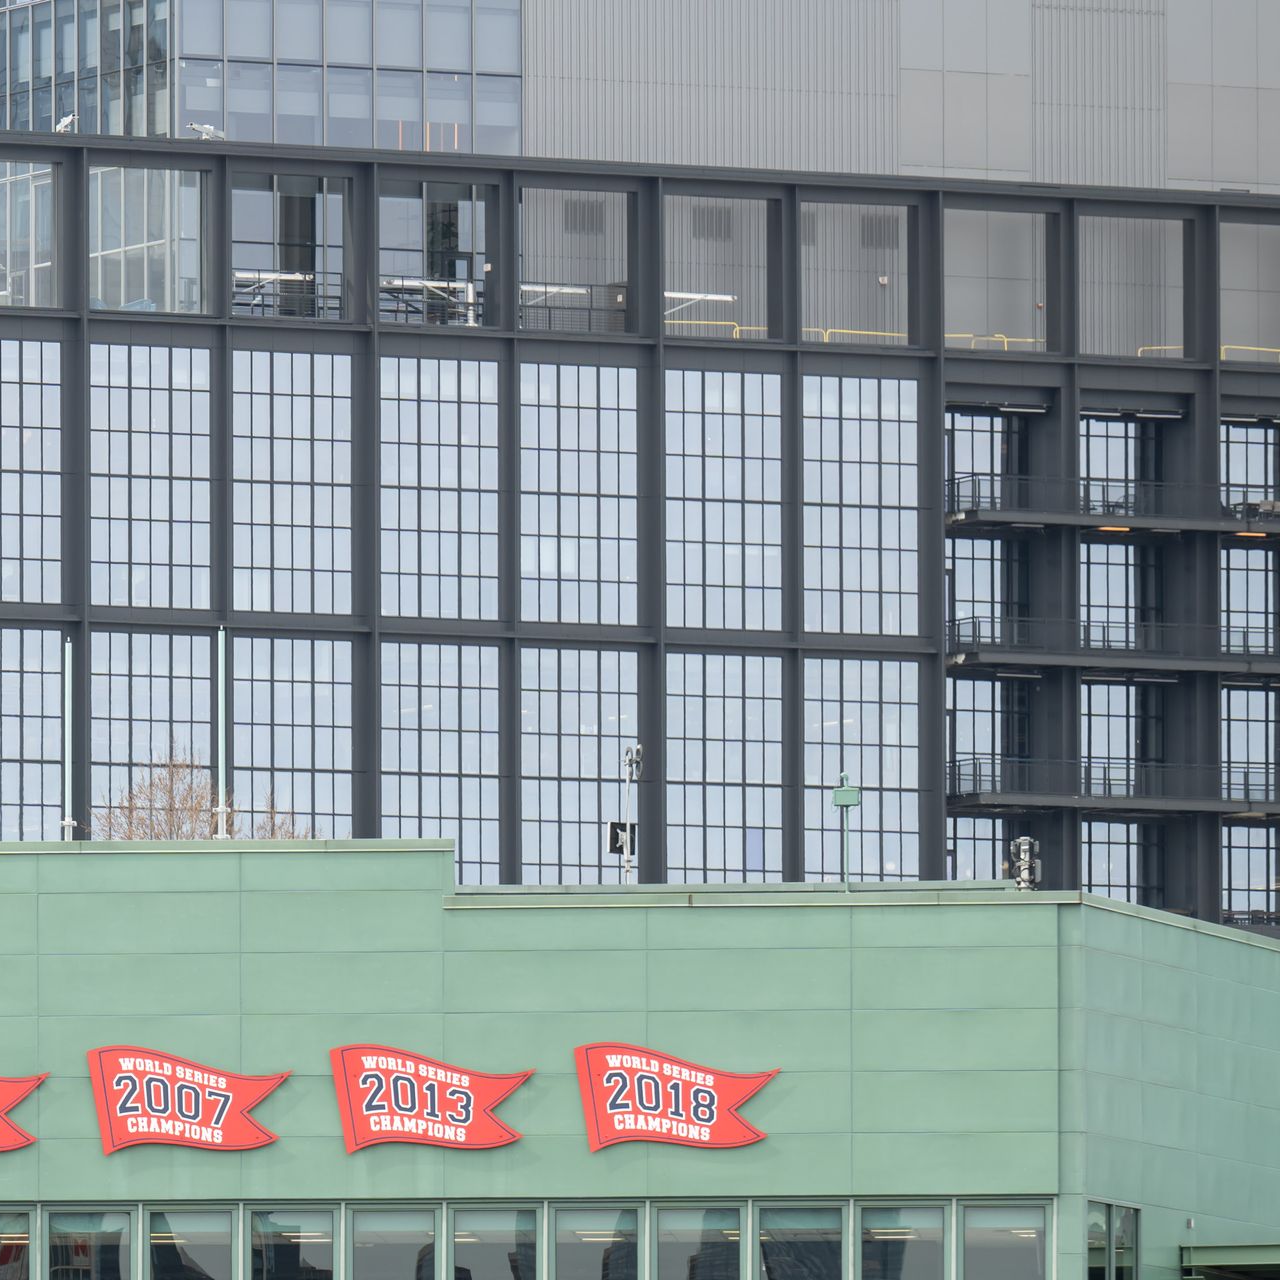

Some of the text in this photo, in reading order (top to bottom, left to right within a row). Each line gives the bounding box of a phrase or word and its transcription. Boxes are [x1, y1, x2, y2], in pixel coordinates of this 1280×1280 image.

[119, 1058, 227, 1089] WORLD SERIES
[361, 1056, 470, 1087] WORLD SERIES
[606, 1054, 714, 1086] WORLD SERIES
[113, 1073, 232, 1129] 2007
[359, 1071, 474, 1126] 2013
[604, 1070, 717, 1125] 2018
[127, 1117, 222, 1143] CHAMPIONS
[370, 1115, 466, 1142] CHAMPIONS
[614, 1114, 710, 1141] CHAMPIONS
